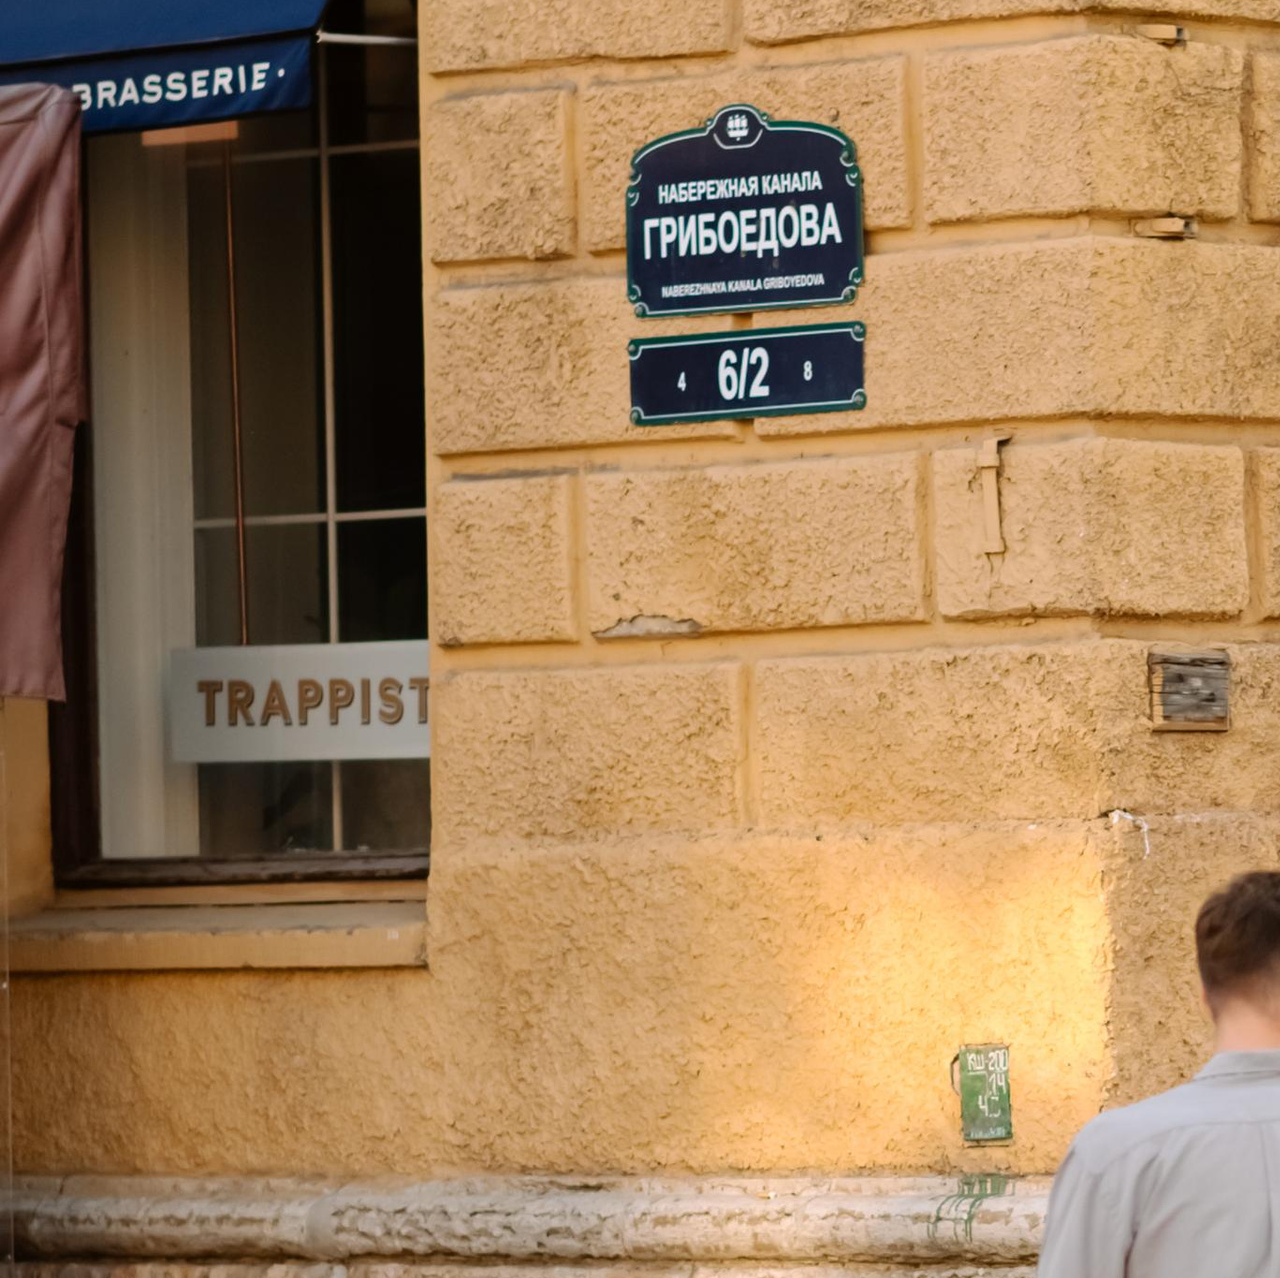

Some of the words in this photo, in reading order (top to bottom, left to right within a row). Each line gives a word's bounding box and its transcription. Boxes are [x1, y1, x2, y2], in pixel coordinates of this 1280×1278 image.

[658, 175, 760, 205] НАБЕРЕЖНАЯ
[762, 171, 823, 196] КАНАЛА
[643, 202, 843, 260] ГРИБОЕДОВА
[661, 280, 727, 298] NABEREZHNAYA
[728, 278, 763, 293] KANALA
[764, 273, 826, 289] GRIBOYEDOVA
[677, 371, 687, 392] 4
[717, 347, 770, 400] 6/2
[803, 360, 813, 381] 8
[197, 676, 430, 727] TRAPPIST
